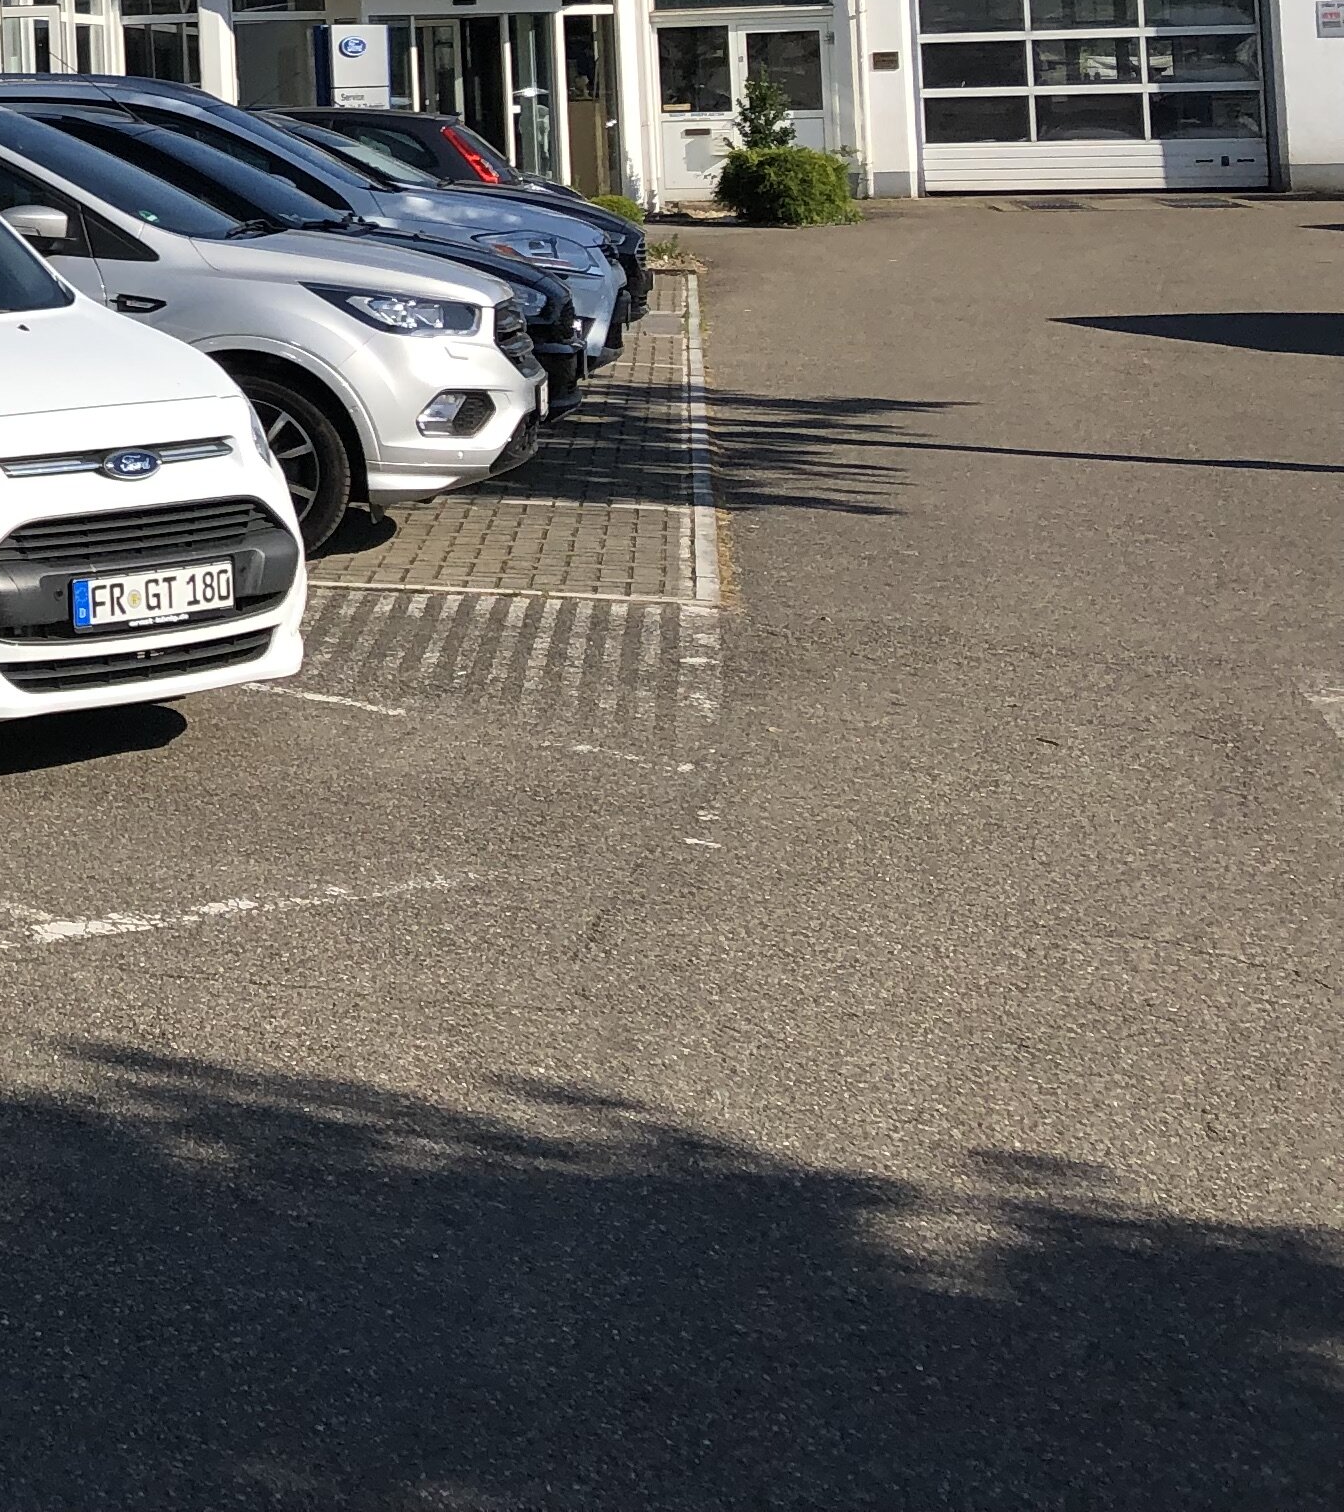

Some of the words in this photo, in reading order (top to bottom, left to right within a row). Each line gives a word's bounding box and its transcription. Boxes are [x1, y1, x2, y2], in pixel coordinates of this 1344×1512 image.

[340, 92, 365, 102] Service
[78, 607, 86, 619] D
[91, 582, 127, 619] FR
[144, 575, 177, 611] GT
[186, 568, 231, 607] 180
